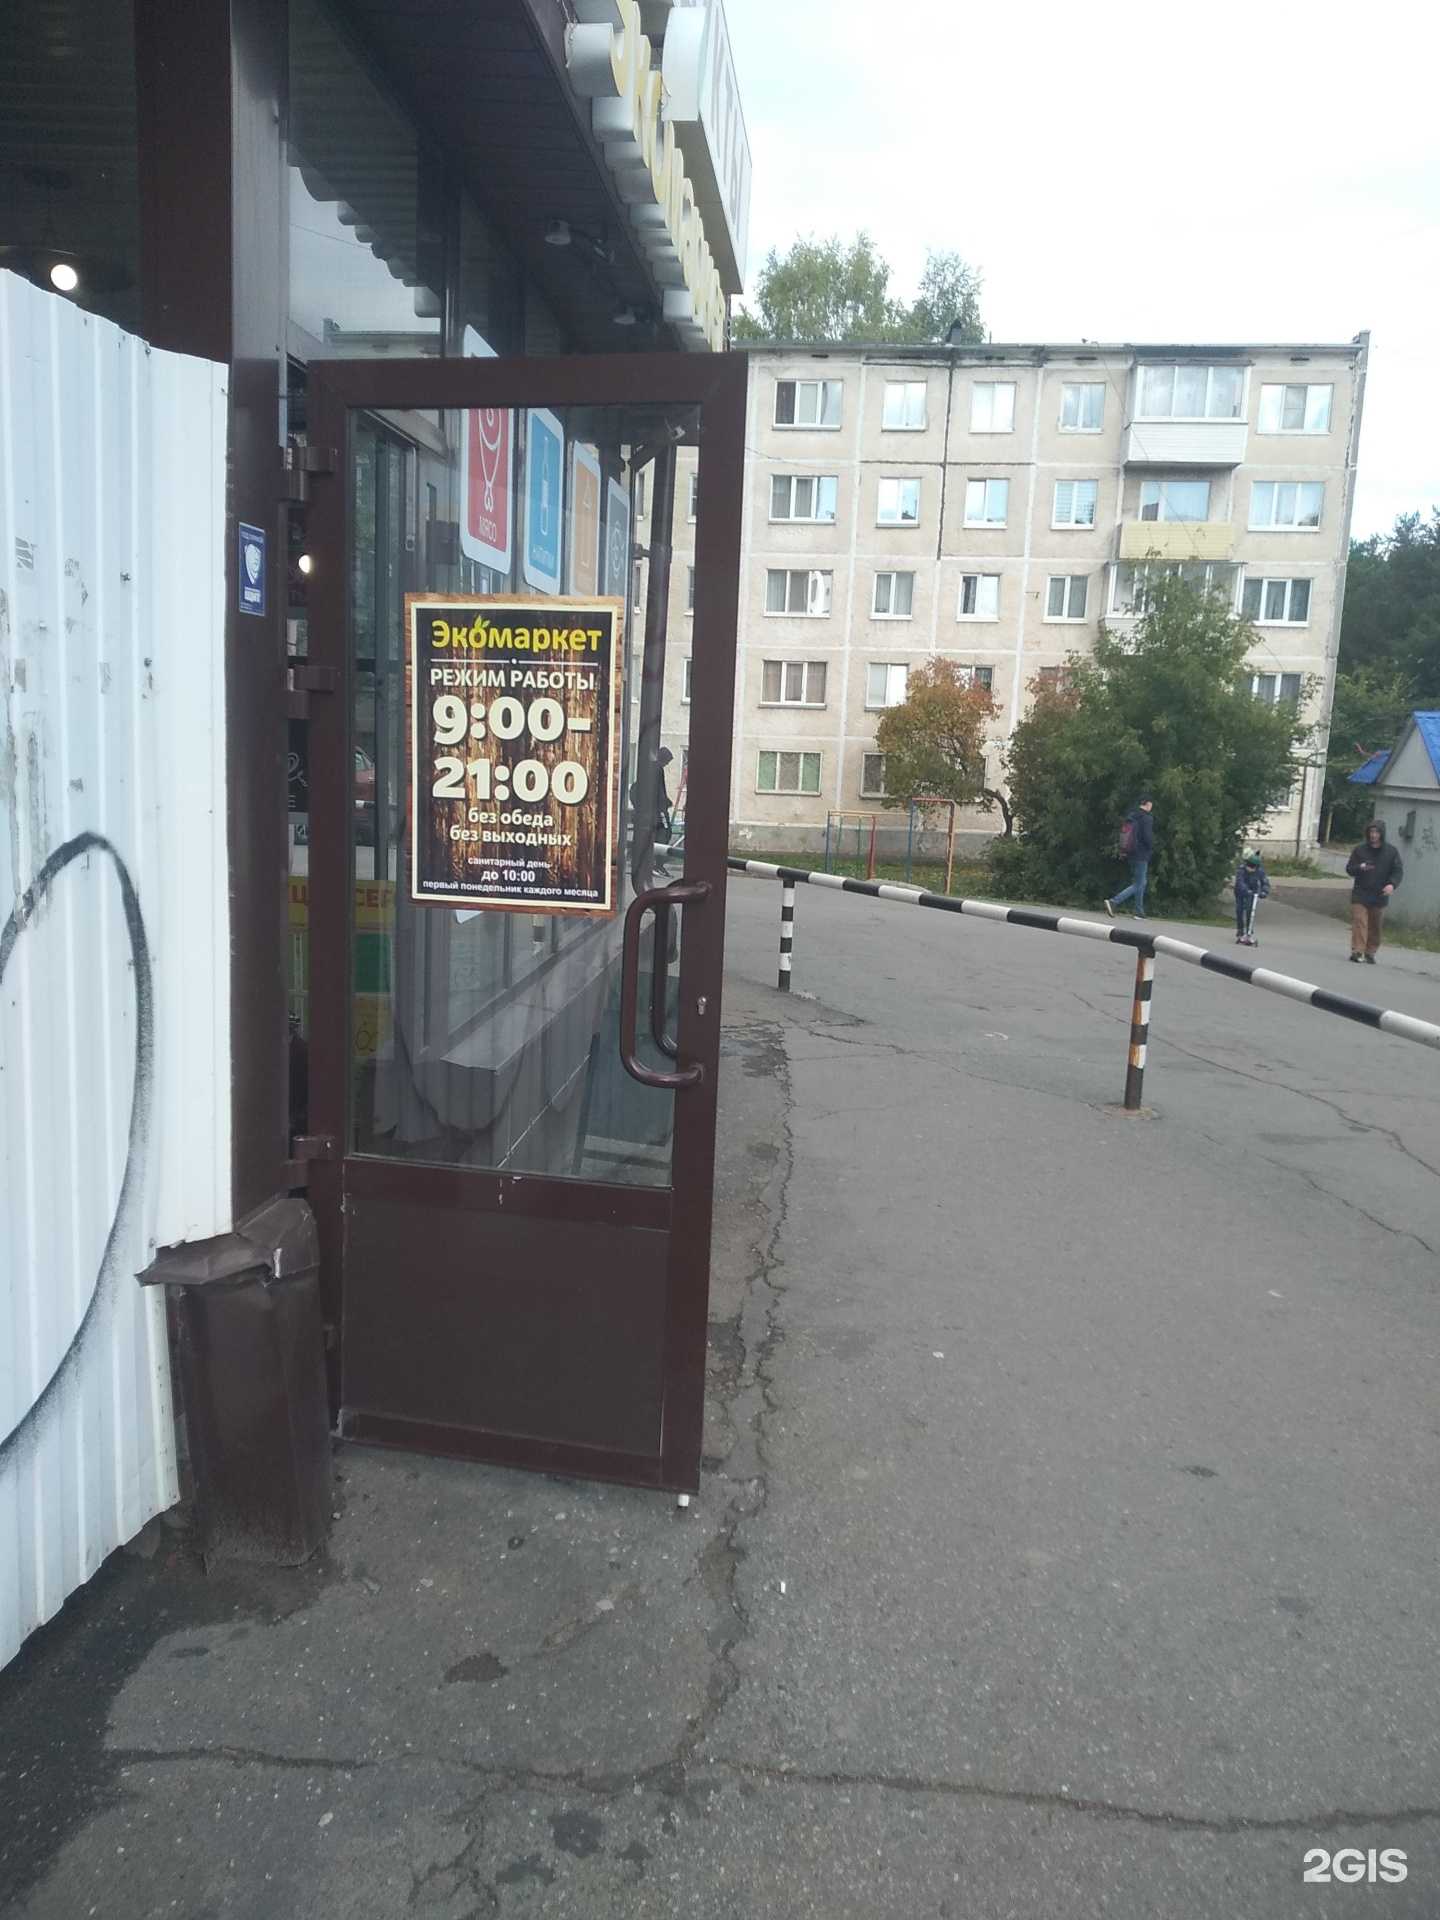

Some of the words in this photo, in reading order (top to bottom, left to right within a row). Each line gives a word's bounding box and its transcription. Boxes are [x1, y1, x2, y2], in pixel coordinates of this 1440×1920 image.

[431, 618, 602, 653] Экомаркет
[430, 668, 505, 687] РЕЖИМ
[510, 670, 594, 690] РАБОТЫ
[432, 695, 591, 744] 9:00-
[432, 756, 588, 804] 21:00
[468, 807, 496, 823] без
[500, 809, 553, 828] обеда
[449, 824, 478, 841] без
[482, 830, 572, 846] выходных
[467, 856, 525, 868] санитарный
[481, 871, 499, 882] до
[502, 870, 536, 882] 10:00
[422, 880, 458, 890] первый
[460, 883, 522, 894] понедельник
[523, 886, 562, 896] каждого
[564, 888, 598, 898] месяца
